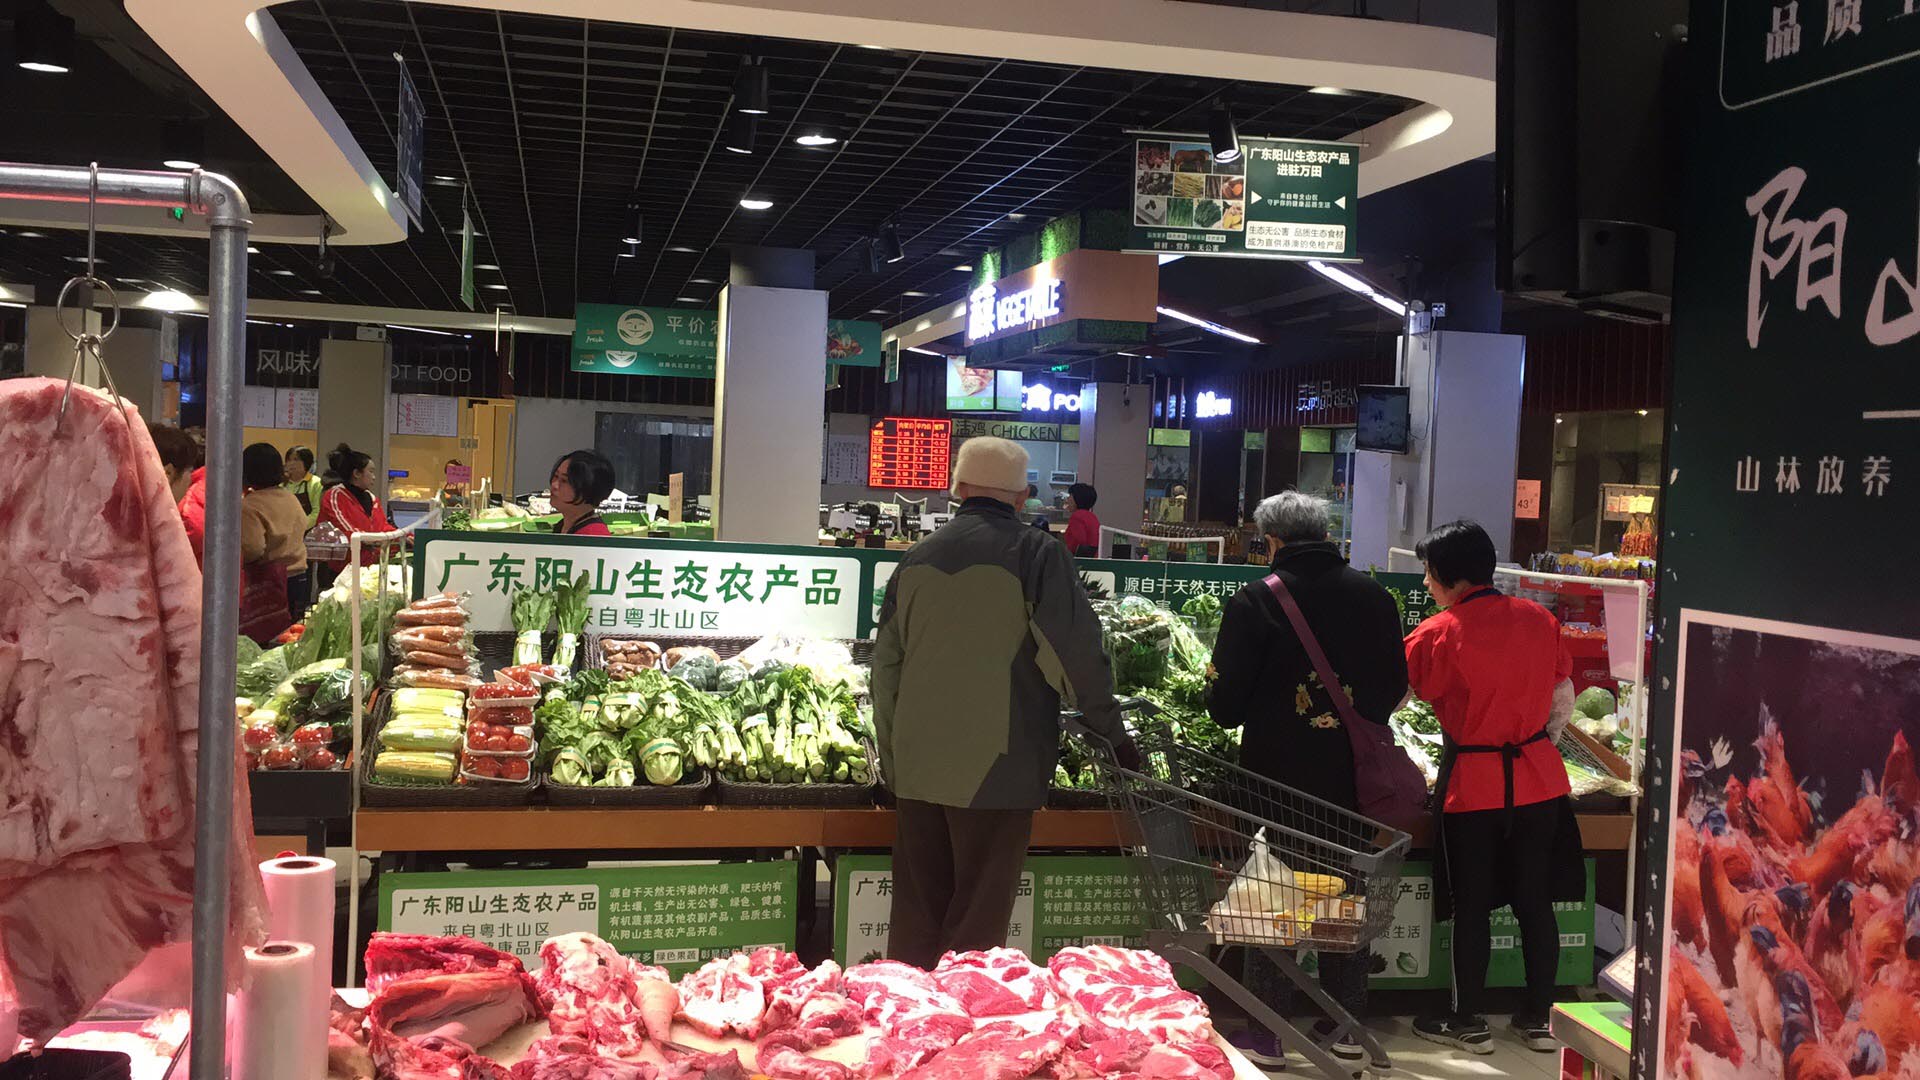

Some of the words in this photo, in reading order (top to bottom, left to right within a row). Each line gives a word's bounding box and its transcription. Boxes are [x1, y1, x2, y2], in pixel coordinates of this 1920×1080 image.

[1250, 147, 1350, 165] 广东阳山生态农产品
[1277, 163, 1323, 178] 进驻万田
[996, 278, 1061, 331] VEGETABLE
[256, 350, 319, 375] 风味
[417, 364, 472, 383] FOOD
[991, 424, 1059, 441] CHICKEN
[1736, 455, 1892, 497] 山林放养
[436, 552, 843, 606] 广东阳山生态农产品
[855, 877, 893, 897] 广东
[399, 891, 597, 916] 广东阳山生态农产品
[442, 922, 550, 938] 来自粤北山区
[859, 922, 890, 937] 守护
